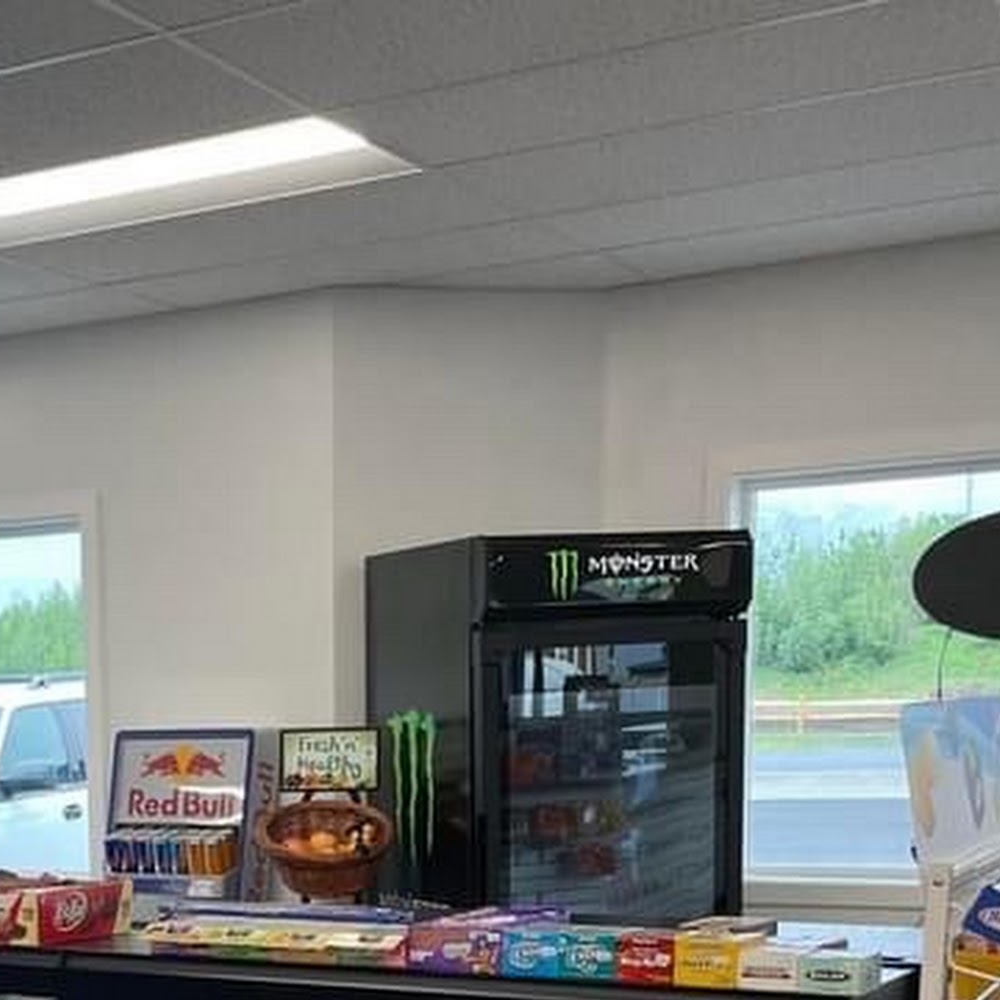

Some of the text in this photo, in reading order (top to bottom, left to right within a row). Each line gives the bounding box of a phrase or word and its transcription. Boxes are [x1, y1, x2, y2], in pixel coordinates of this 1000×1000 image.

[588, 552, 700, 575] MONSTER
[128, 788, 235, 818] Red Bull
